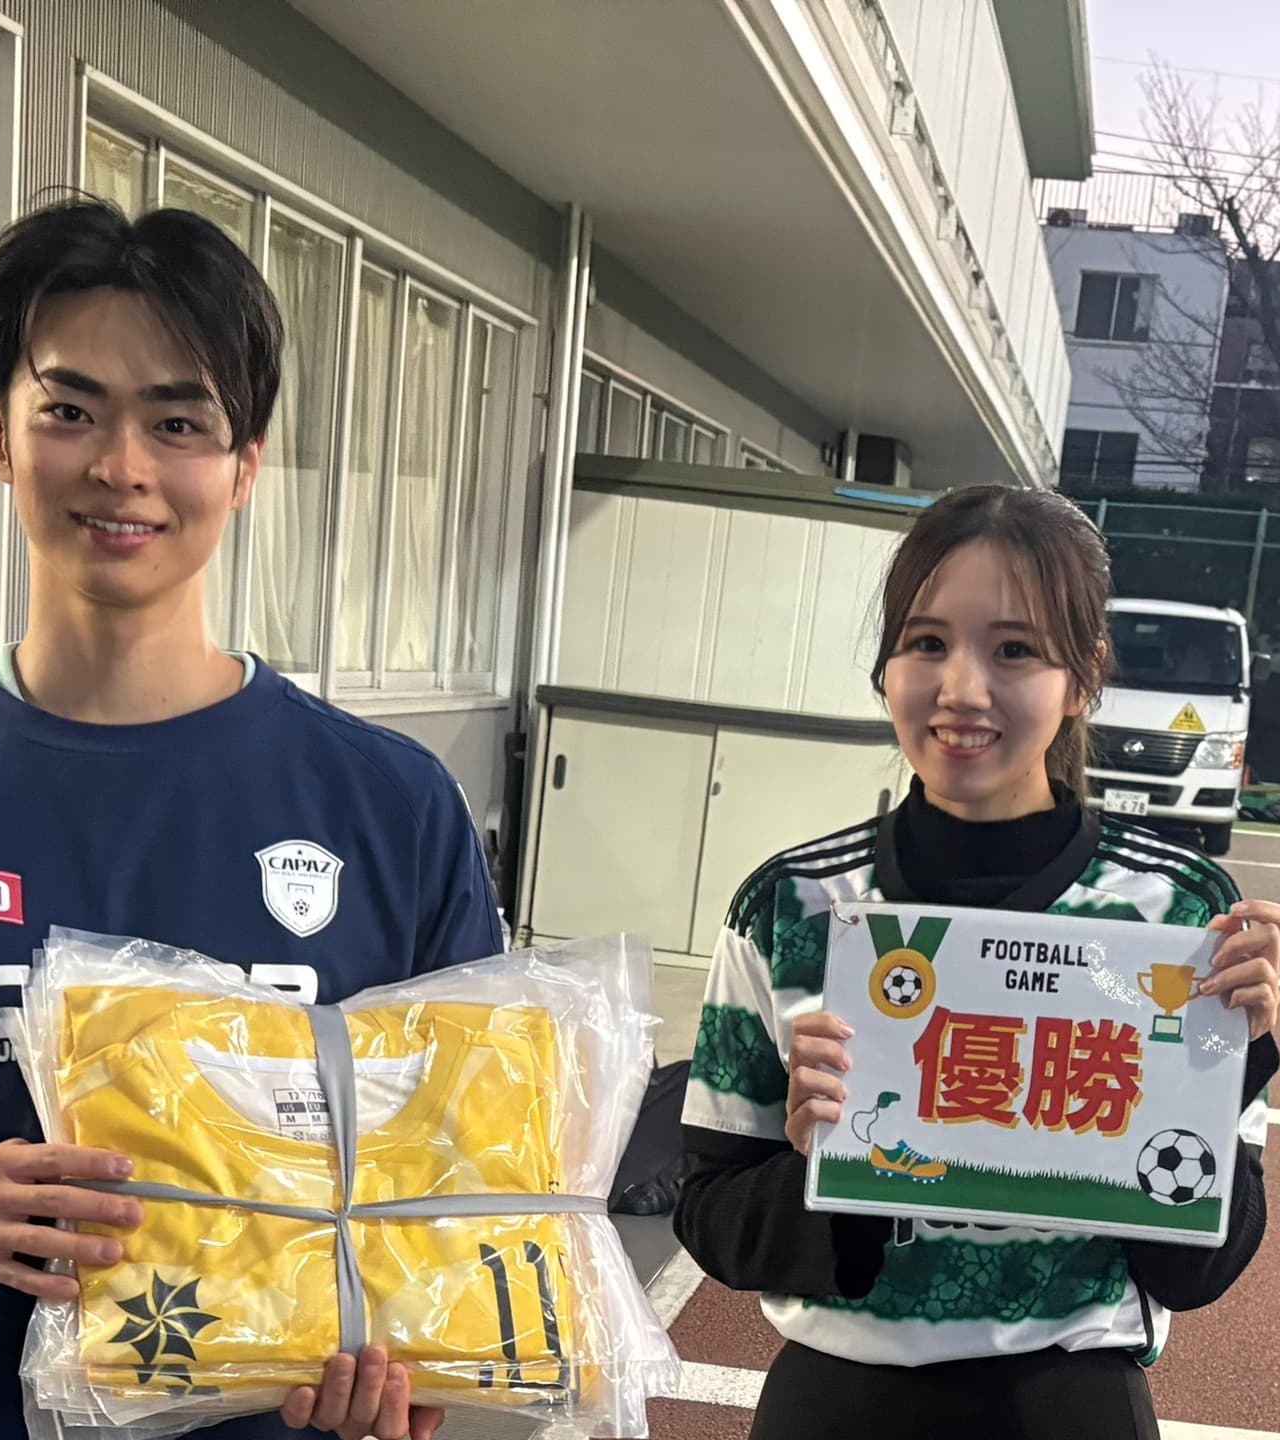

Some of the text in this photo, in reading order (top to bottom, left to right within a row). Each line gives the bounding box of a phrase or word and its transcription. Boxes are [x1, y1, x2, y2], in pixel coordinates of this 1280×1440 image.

[269, 857, 332, 873] CAPAZ
[980, 938, 1089, 967] FOOTBALL
[1004, 969, 1060, 993] GAME
[912, 1005, 1144, 1137] 優勝
[286, 1114, 296, 1123] M
[479, 1240, 563, 1361] 11
